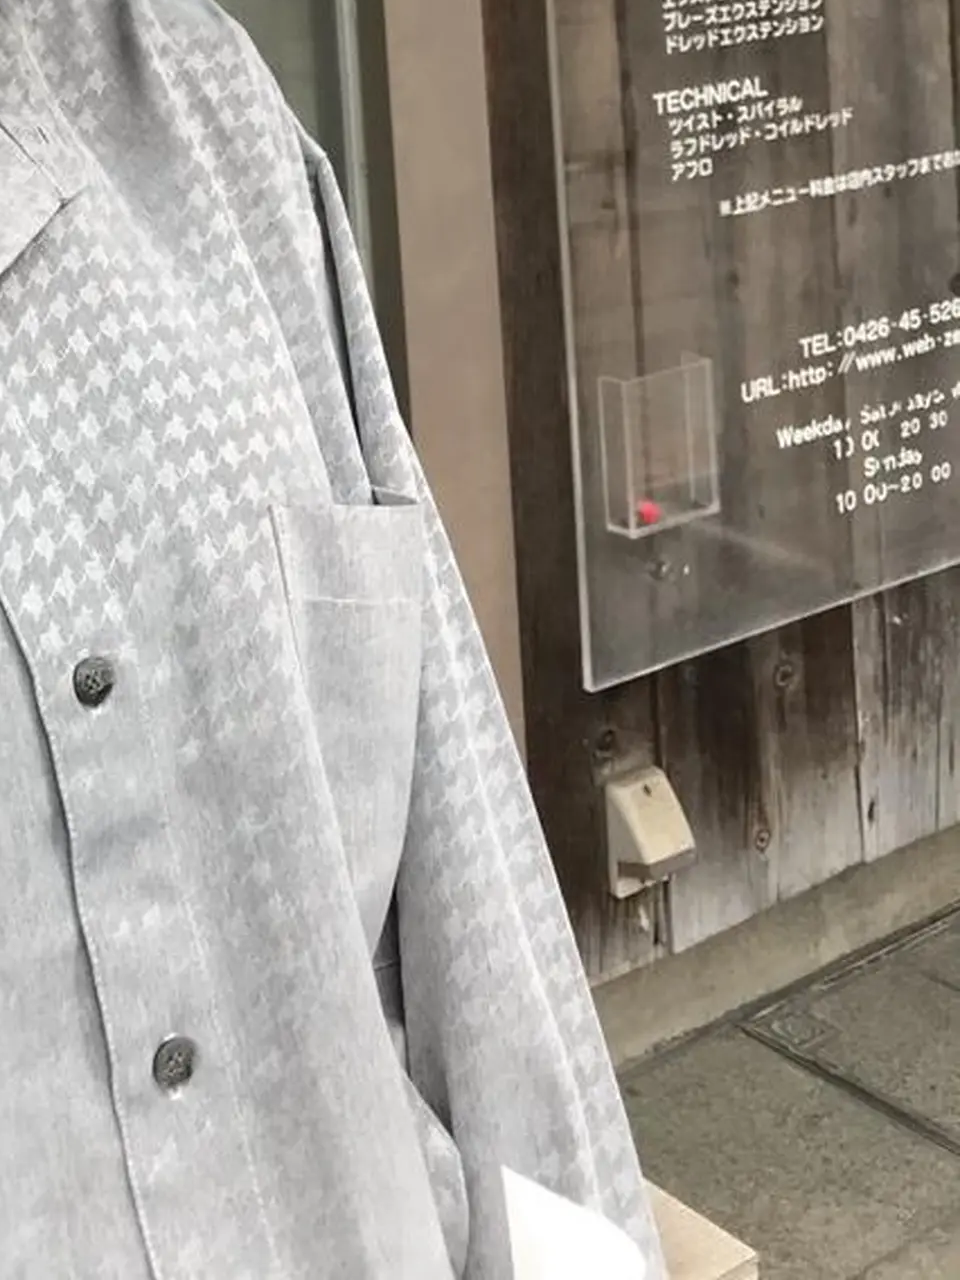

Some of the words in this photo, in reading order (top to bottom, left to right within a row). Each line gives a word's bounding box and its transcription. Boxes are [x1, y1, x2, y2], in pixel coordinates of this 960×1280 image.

[665, 14, 825, 55] ドレッドエクステンション
[652, 76, 769, 115] TECHNICAL
[671, 157, 714, 182] アフロ
